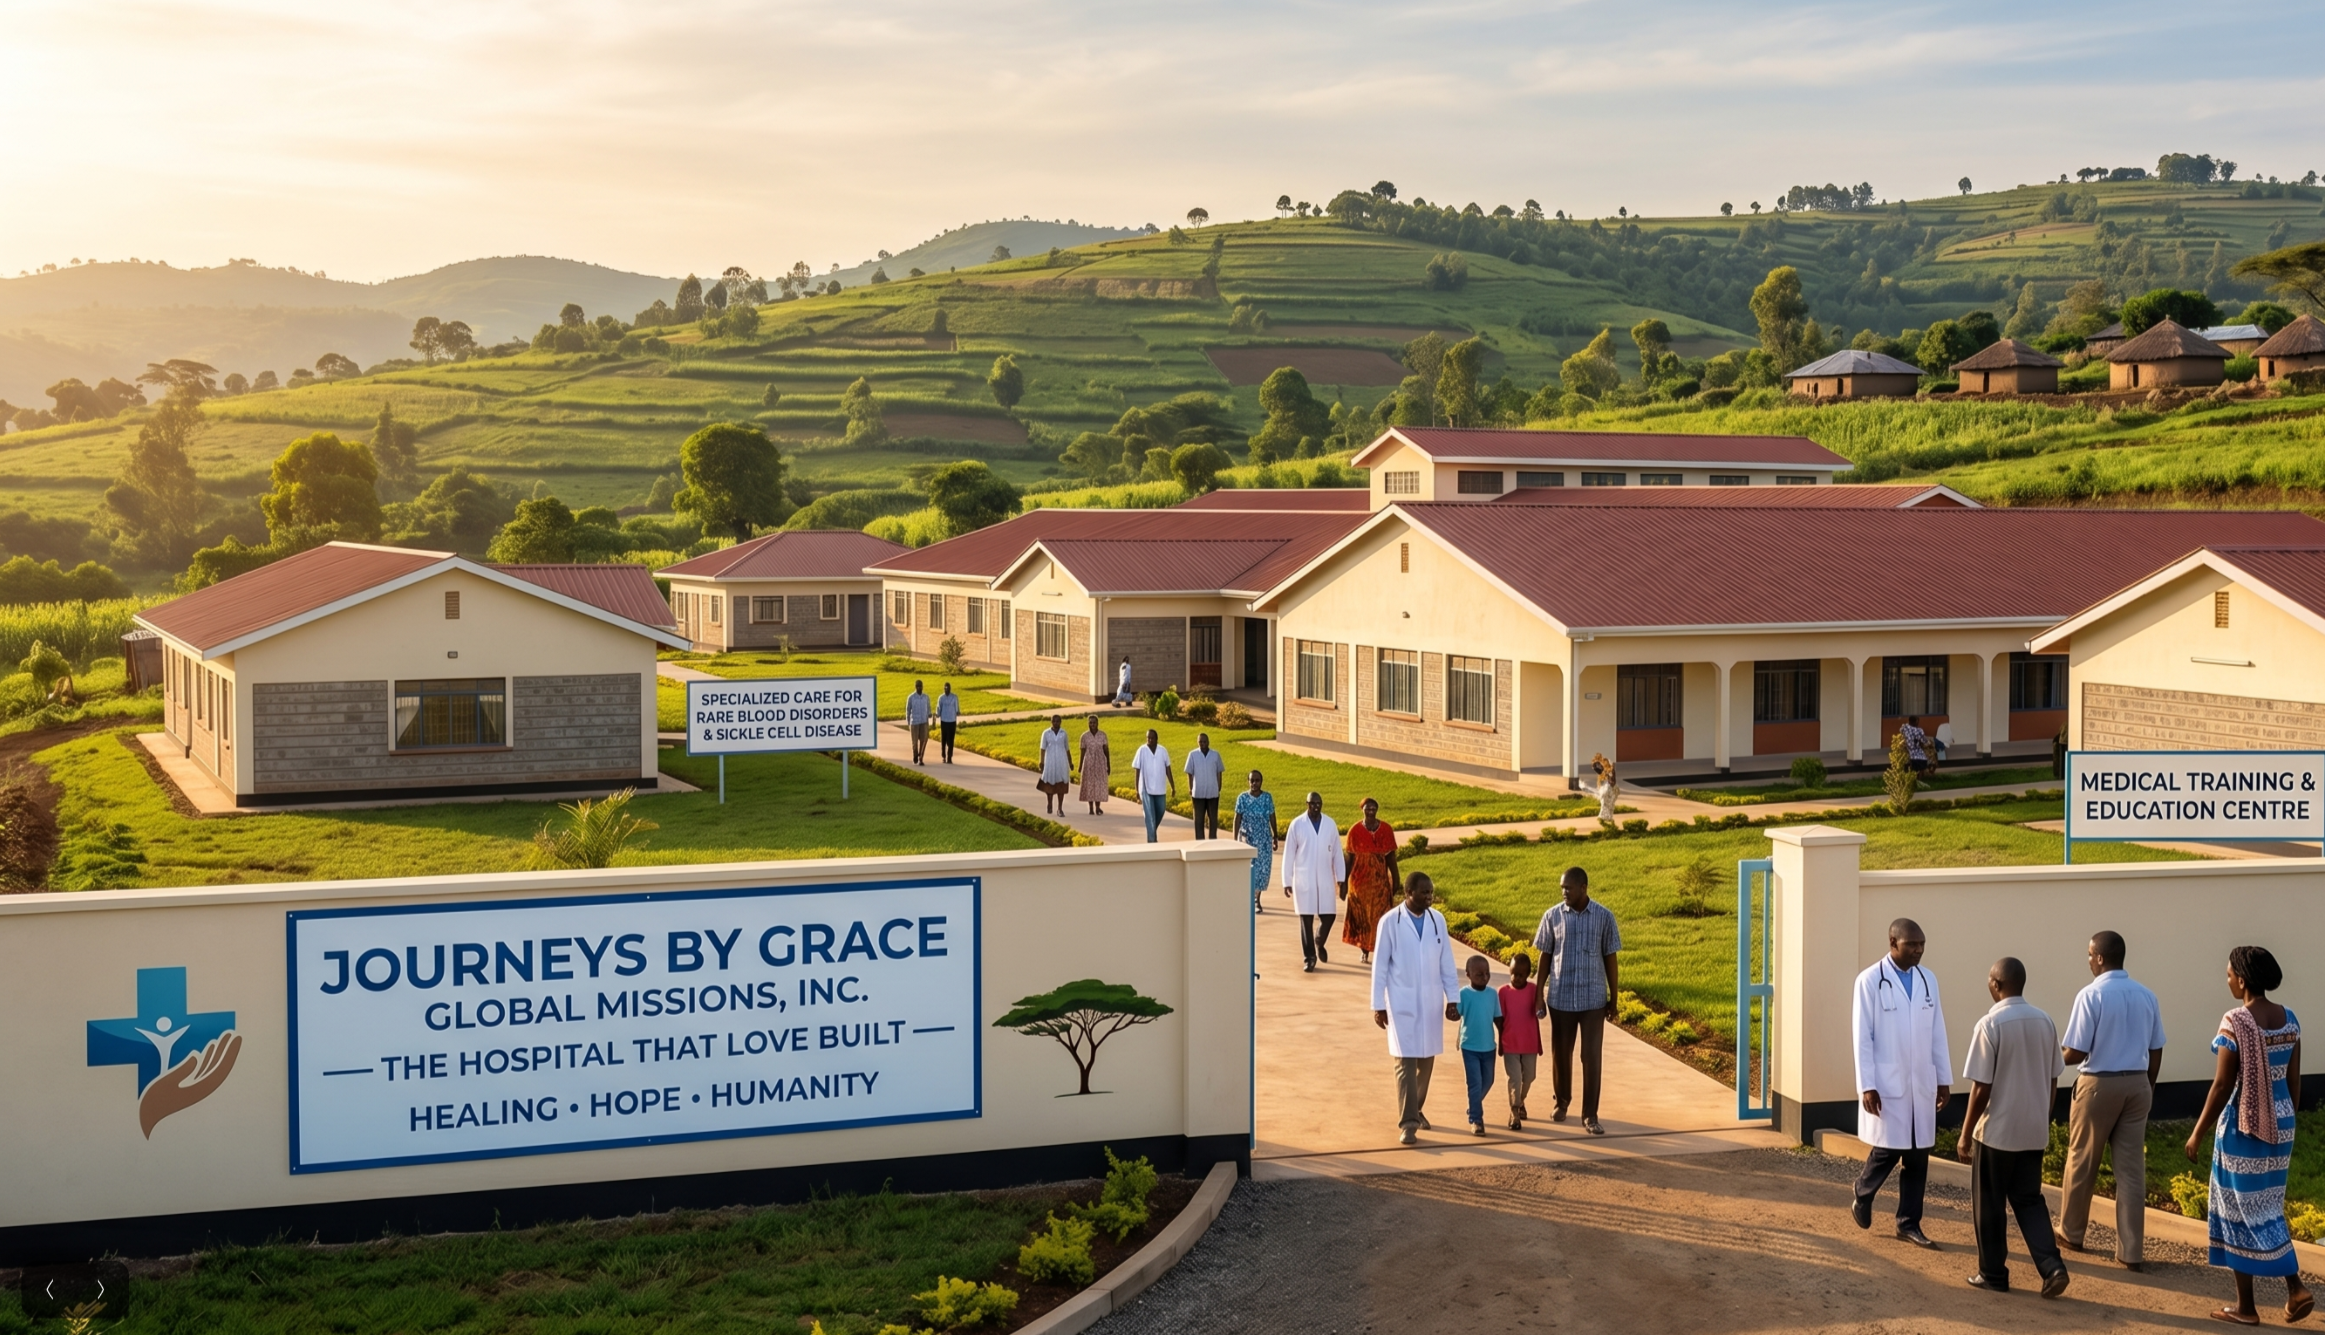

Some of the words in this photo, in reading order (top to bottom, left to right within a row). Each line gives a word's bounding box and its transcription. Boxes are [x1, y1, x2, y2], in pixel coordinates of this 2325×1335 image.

[701, 692, 790, 706] SPECIALIZED
[793, 691, 831, 704] CARE
[834, 690, 863, 703] FOR
[696, 710, 734, 724] RARE
[738, 709, 786, 723] BLOOD
[789, 707, 868, 721] DISORDERS
[703, 728, 714, 741] &
[716, 727, 765, 741] SICKLE
[767, 726, 801, 739] CELL
[805, 724, 862, 738] DISEASE
[2081, 772, 2181, 792] MEDICAL
[2186, 772, 2294, 792] TRAINING
[2300, 772, 2316, 792] &
[2086, 800, 2215, 820] EDUCATION
[2222, 800, 2310, 820] CENTRE
[319, 932, 649, 995] JOURNEYS
[667, 928, 745, 973] BY
[758, 915, 949, 967] GRACE
[424, 995, 586, 1032] GLOBAL
[597, 981, 787, 1020] MISSIONS,
[799, 976, 870, 1006] INC.
[380, 1053, 448, 1082] THE
[459, 1041, 625, 1077] HOSPITAL
[632, 1034, 718, 1064] THAT
[727, 1027, 810, 1057] LOVE
[819, 1020, 907, 1051] BUILT
[410, 1096, 559, 1133] HEALING
[590, 1086, 682, 1119] HOPE
[711, 1071, 880, 1109] HUMANITY
